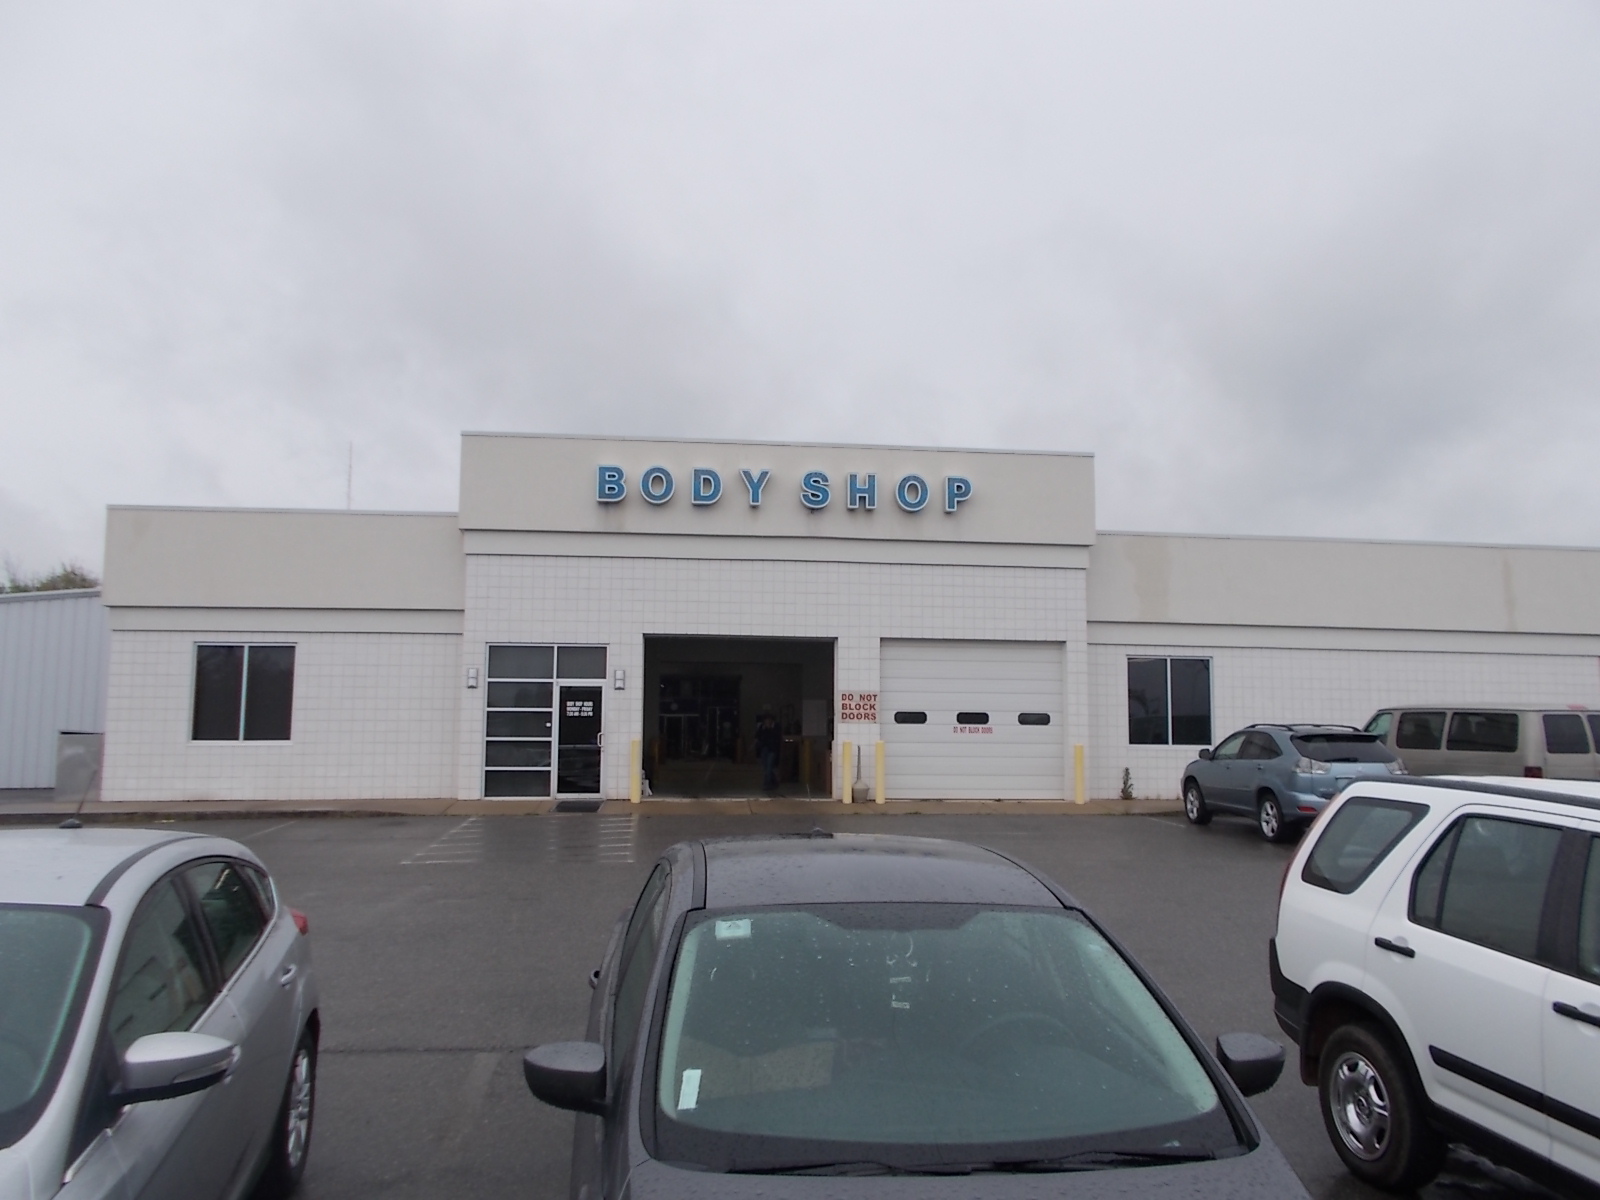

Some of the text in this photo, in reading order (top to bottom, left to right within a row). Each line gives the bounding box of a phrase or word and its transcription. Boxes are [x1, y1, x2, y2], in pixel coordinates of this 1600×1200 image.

[597, 464, 973, 513] BODY SHOP
[841, 693, 878, 702] DO NOT
[841, 702, 877, 711] BLOCK
[841, 712, 877, 721] DOORS
[953, 726, 993, 734] DO NOT BLOCK DOORS
